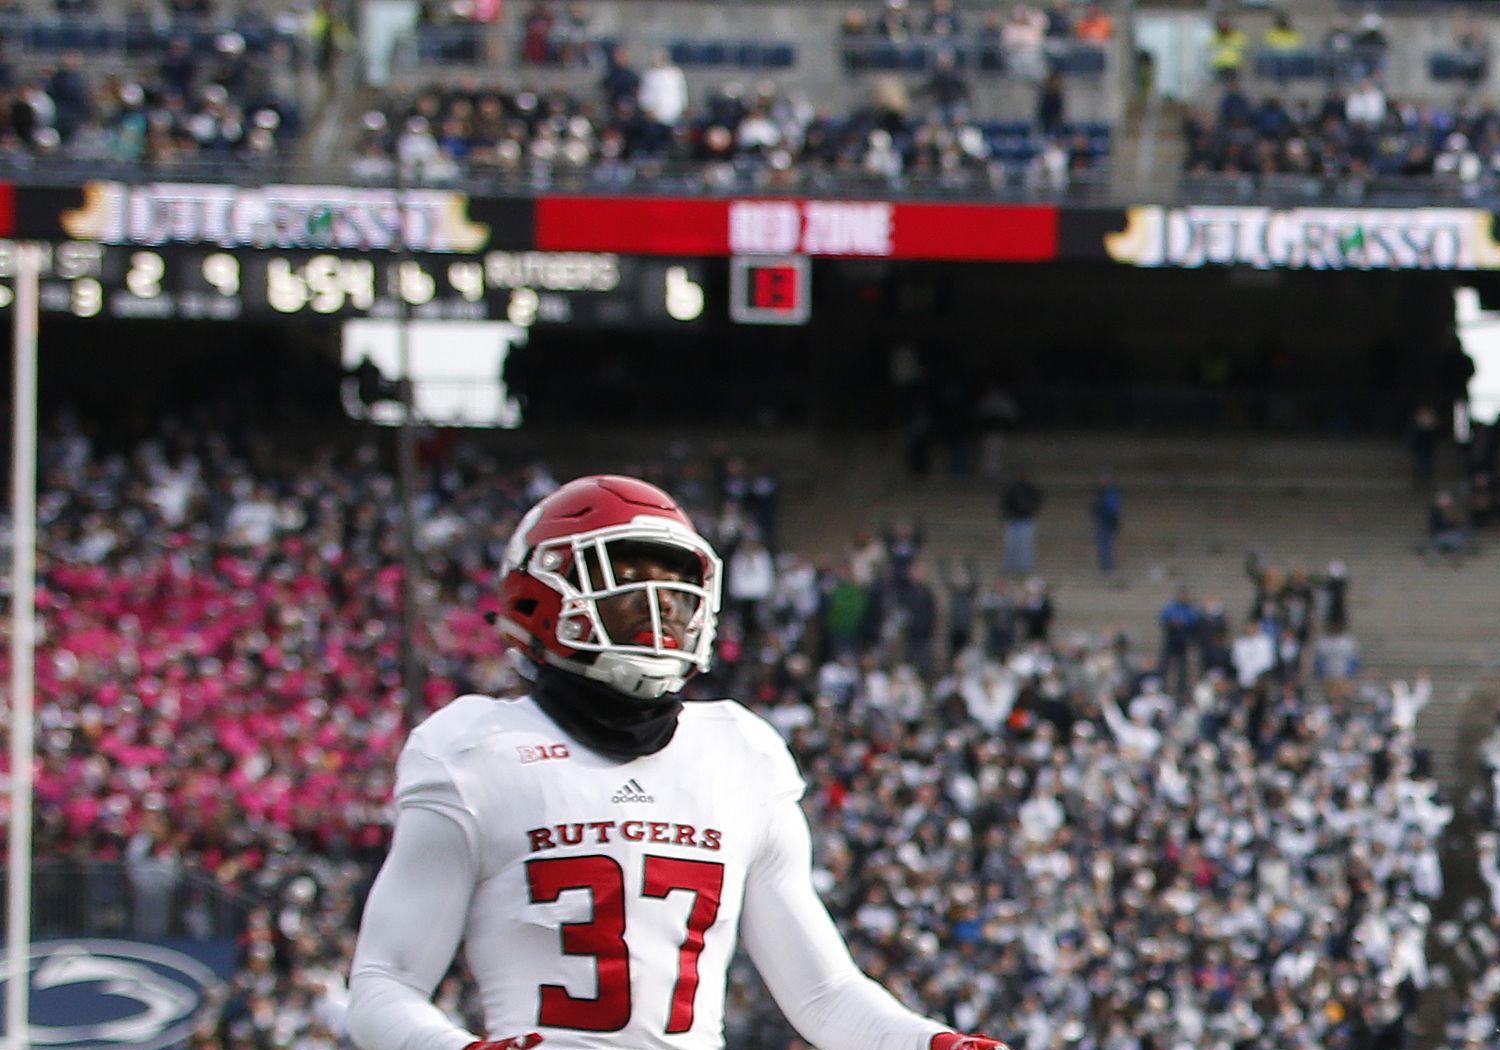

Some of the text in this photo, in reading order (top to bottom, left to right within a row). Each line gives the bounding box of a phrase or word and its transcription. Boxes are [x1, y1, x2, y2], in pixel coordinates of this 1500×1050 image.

[729, 202, 894, 256] RED ZONE
[527, 820, 722, 851] RUTGERS
[525, 854, 725, 1034] 37
